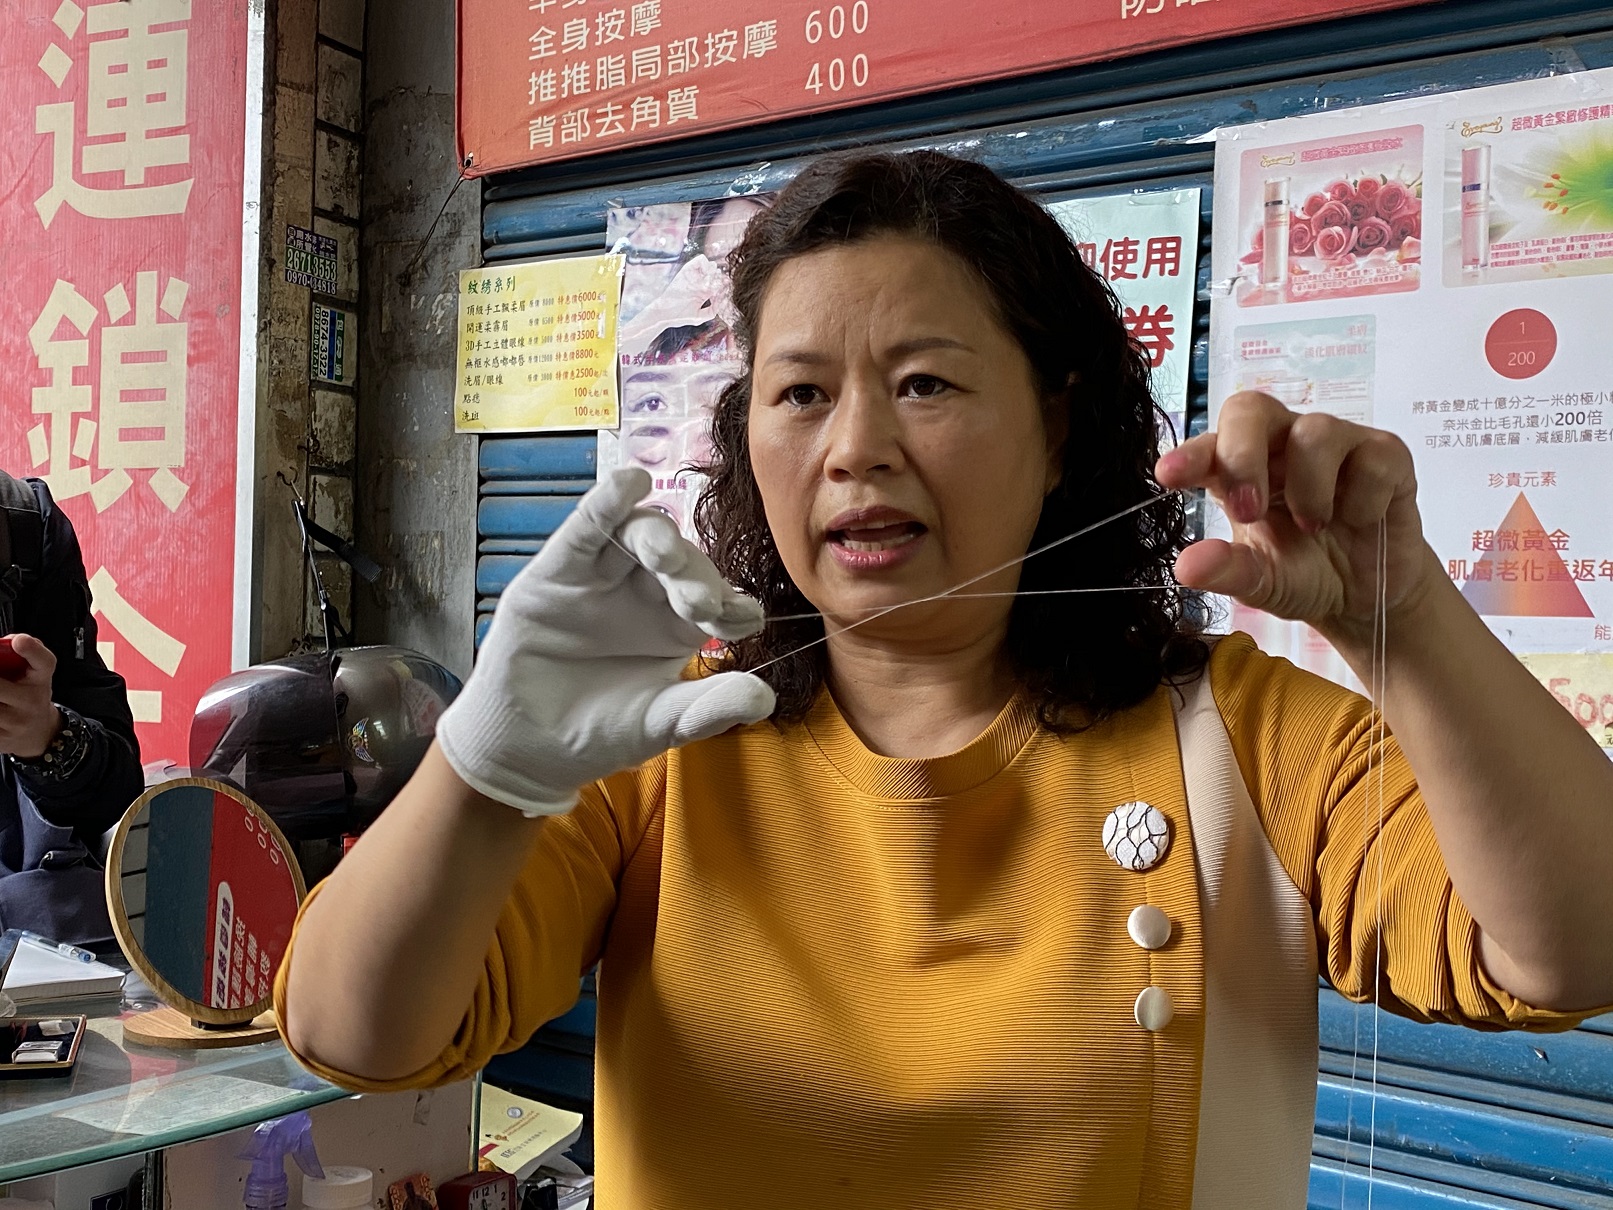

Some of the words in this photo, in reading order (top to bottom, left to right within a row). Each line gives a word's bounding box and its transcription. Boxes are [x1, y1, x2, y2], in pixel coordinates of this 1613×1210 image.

[528, 0, 662, 60] 全身按摩
[805, 0, 869, 44] 600
[528, 19, 777, 105] 推推脂局部按摩
[805, 53, 869, 96] 400
[529, 85, 699, 150] 背部去角質
[1519, 320, 1526, 335] 1
[1507, 350, 1536, 367] 200
[1442, 410, 1603, 432] 奈米金比毛孔還小200倍
[1488, 471, 1557, 488] 珍貴元素
[1472, 528, 1570, 552] 超微黃金
[1448, 558, 1613, 583] 肌膚老化重返年
